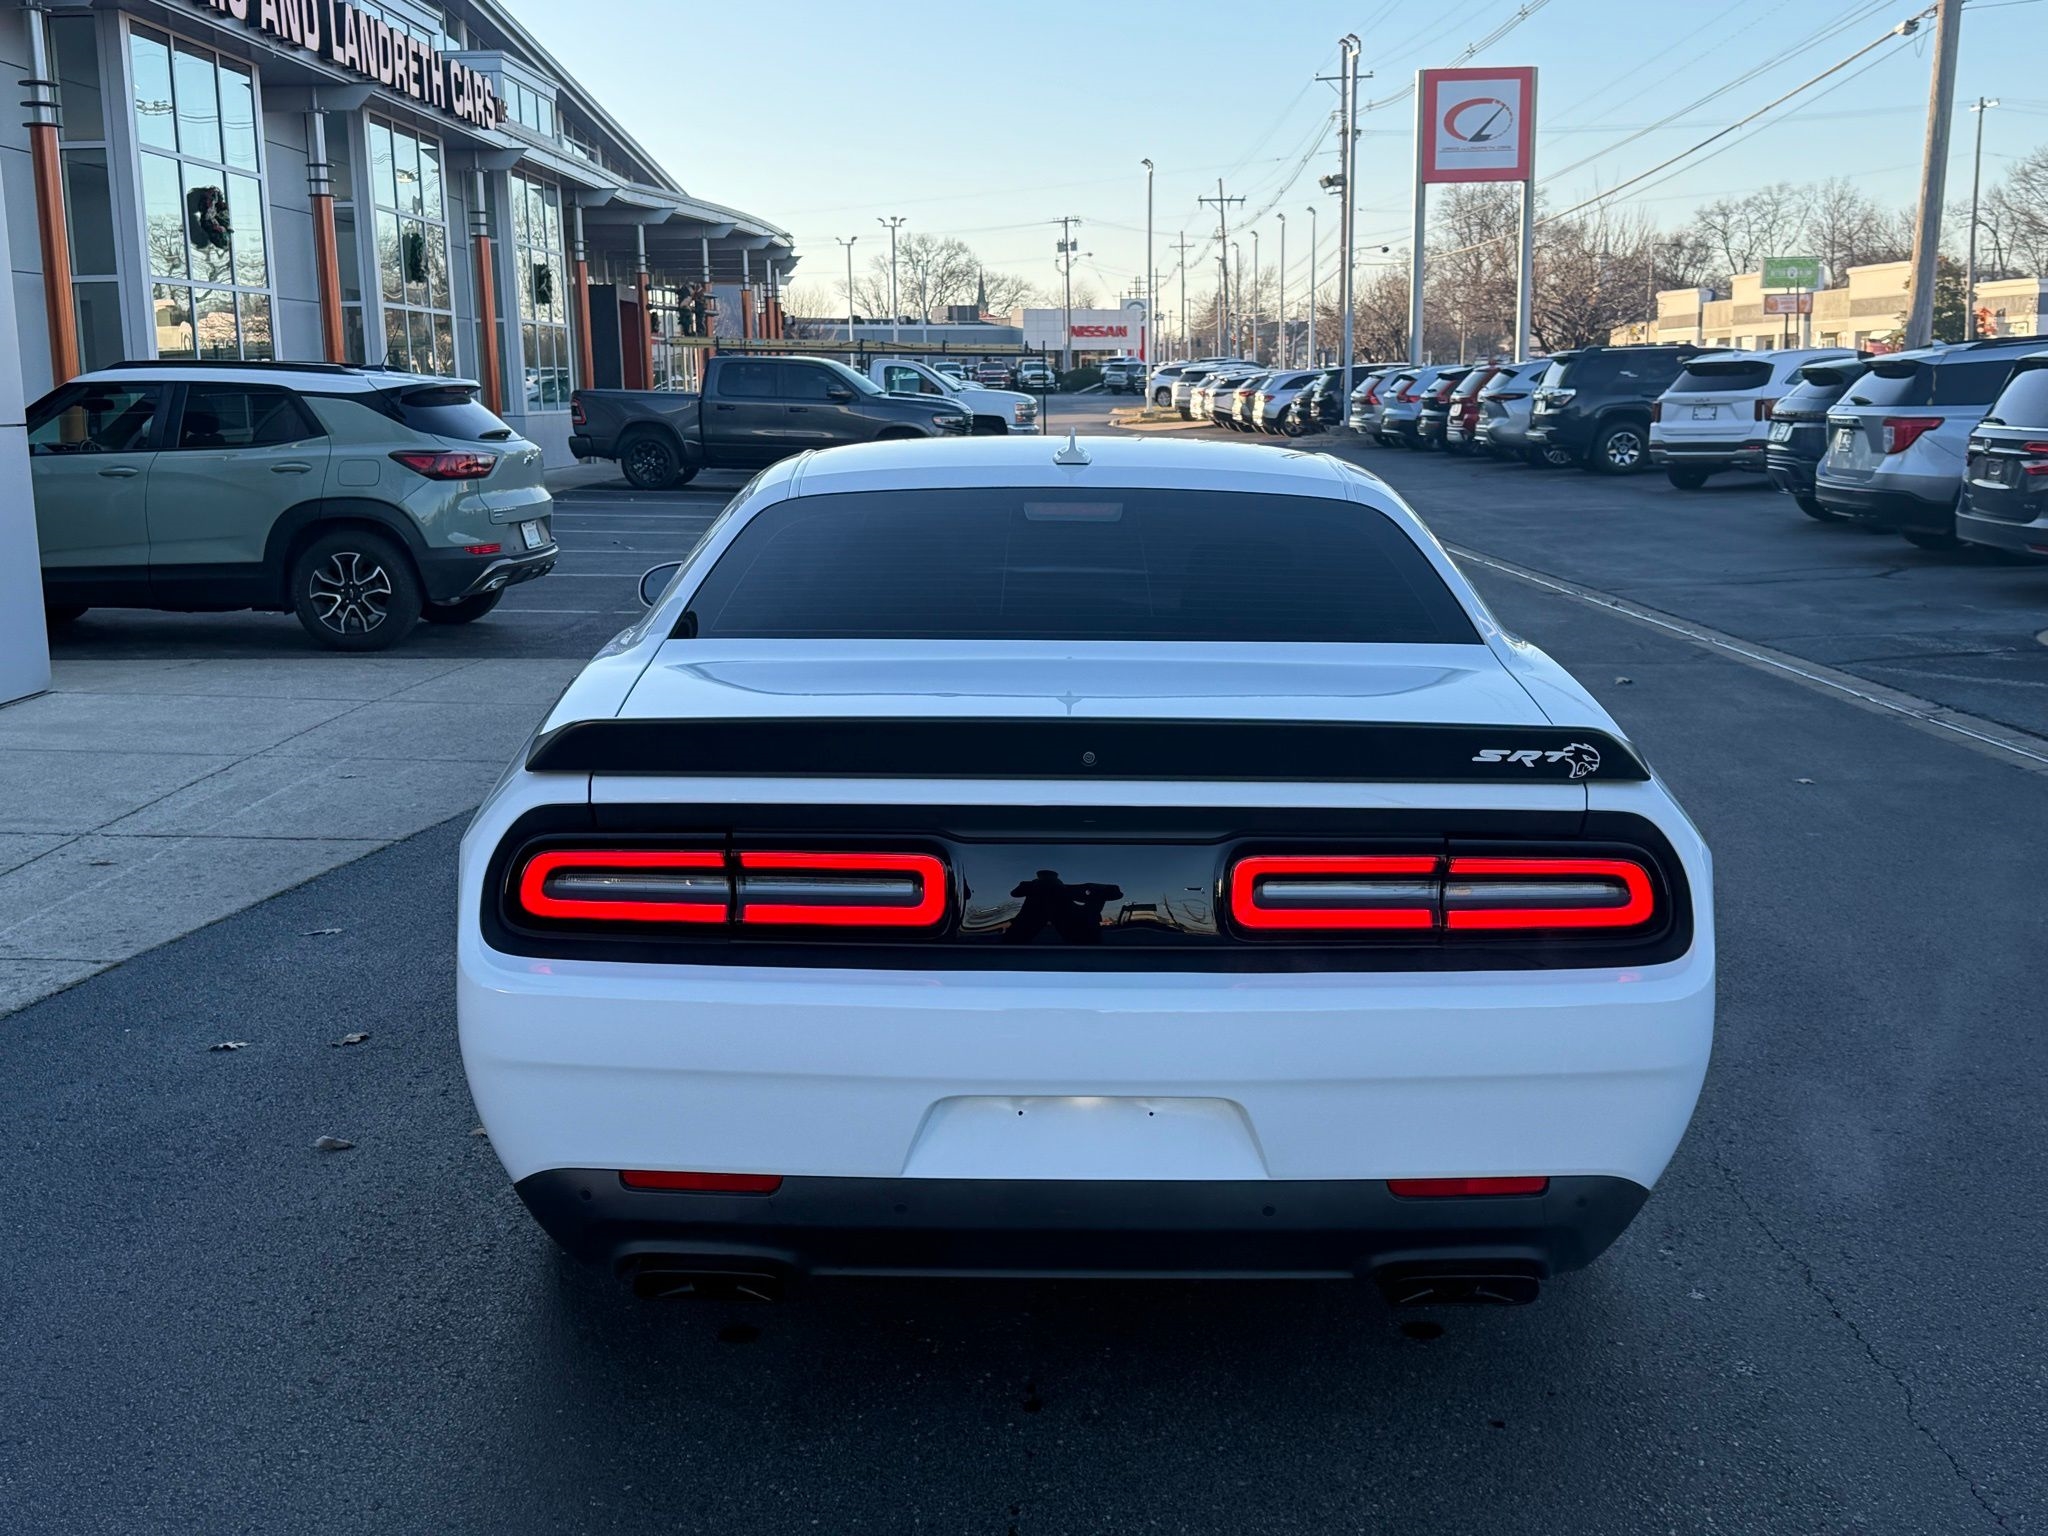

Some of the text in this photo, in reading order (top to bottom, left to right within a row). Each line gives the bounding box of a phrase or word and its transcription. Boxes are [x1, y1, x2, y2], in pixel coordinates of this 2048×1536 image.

[261, 0, 320, 52] AND
[328, 0, 446, 109] LANDRETH
[450, 58, 496, 130] CARS
[1070, 325, 1127, 337] NISSAN
[1471, 749, 1574, 767] SRT
